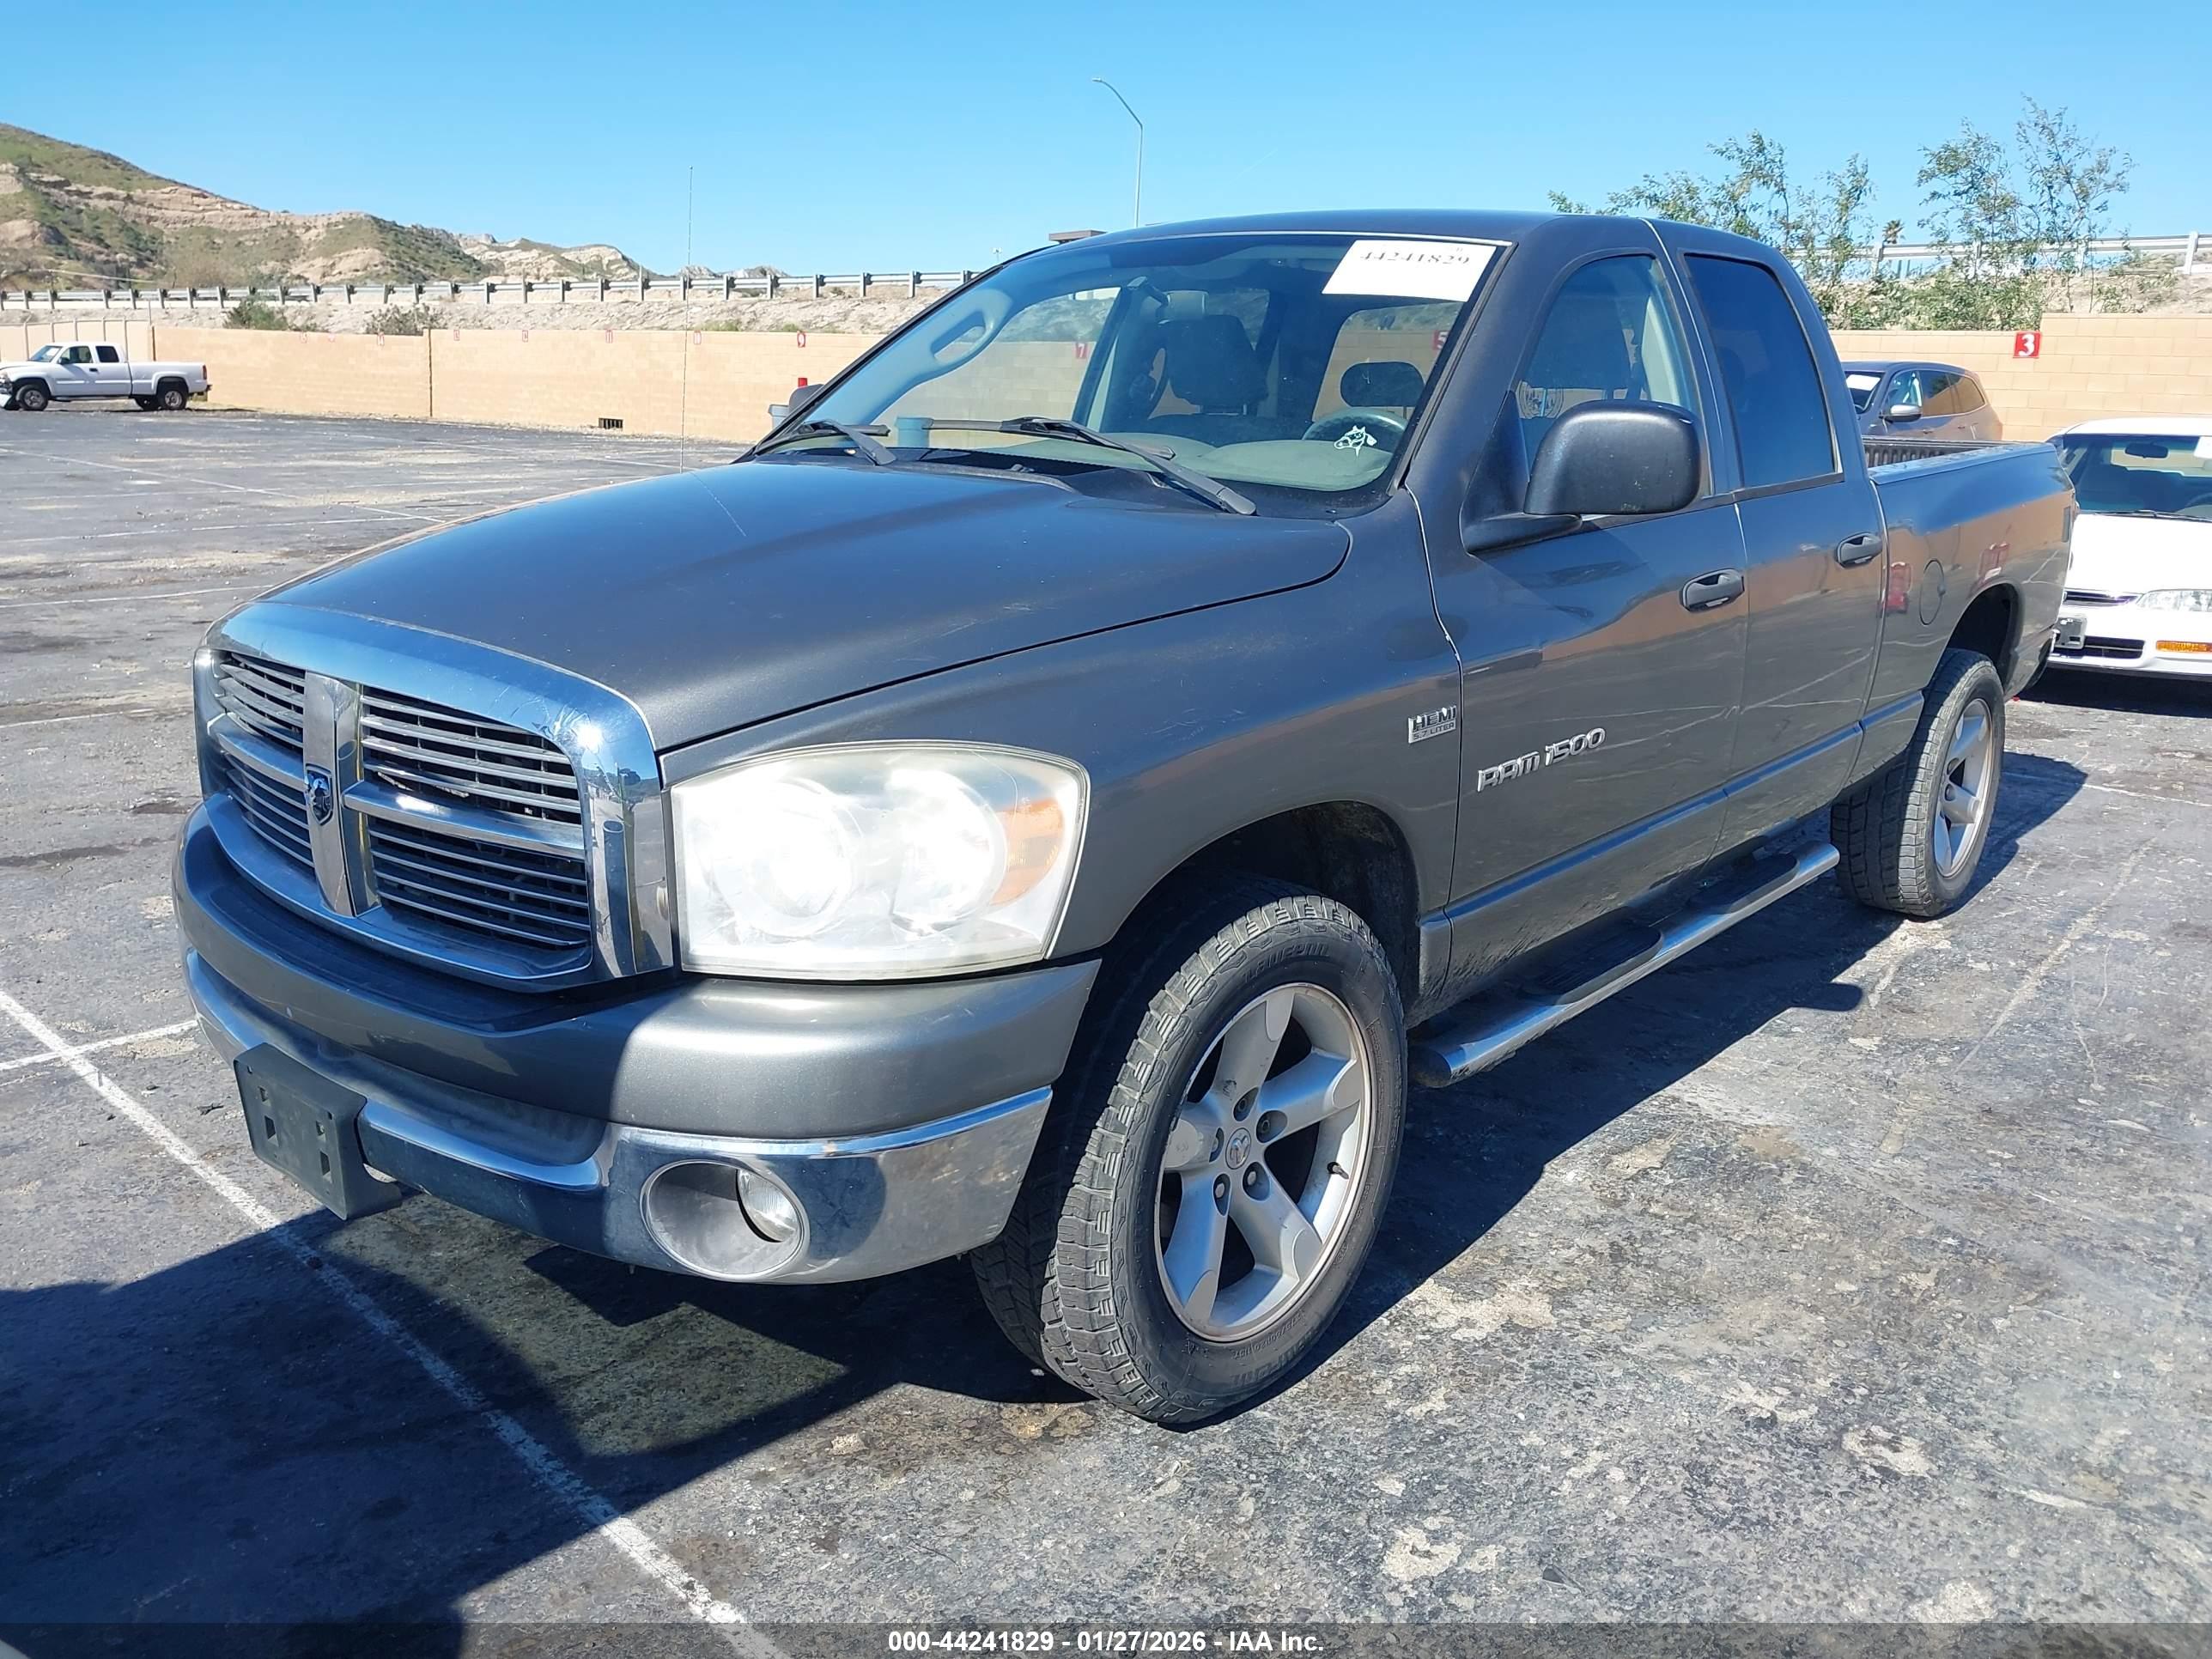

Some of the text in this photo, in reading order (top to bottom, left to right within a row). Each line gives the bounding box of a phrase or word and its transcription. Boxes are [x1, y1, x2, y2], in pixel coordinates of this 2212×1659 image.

[1359, 251, 1470, 264] 44241829
[1078, 343, 1085, 358] 7
[2018, 333, 2035, 357] 3
[1410, 705, 1457, 732] HEMI
[1476, 726, 1607, 793] RAM 1500
